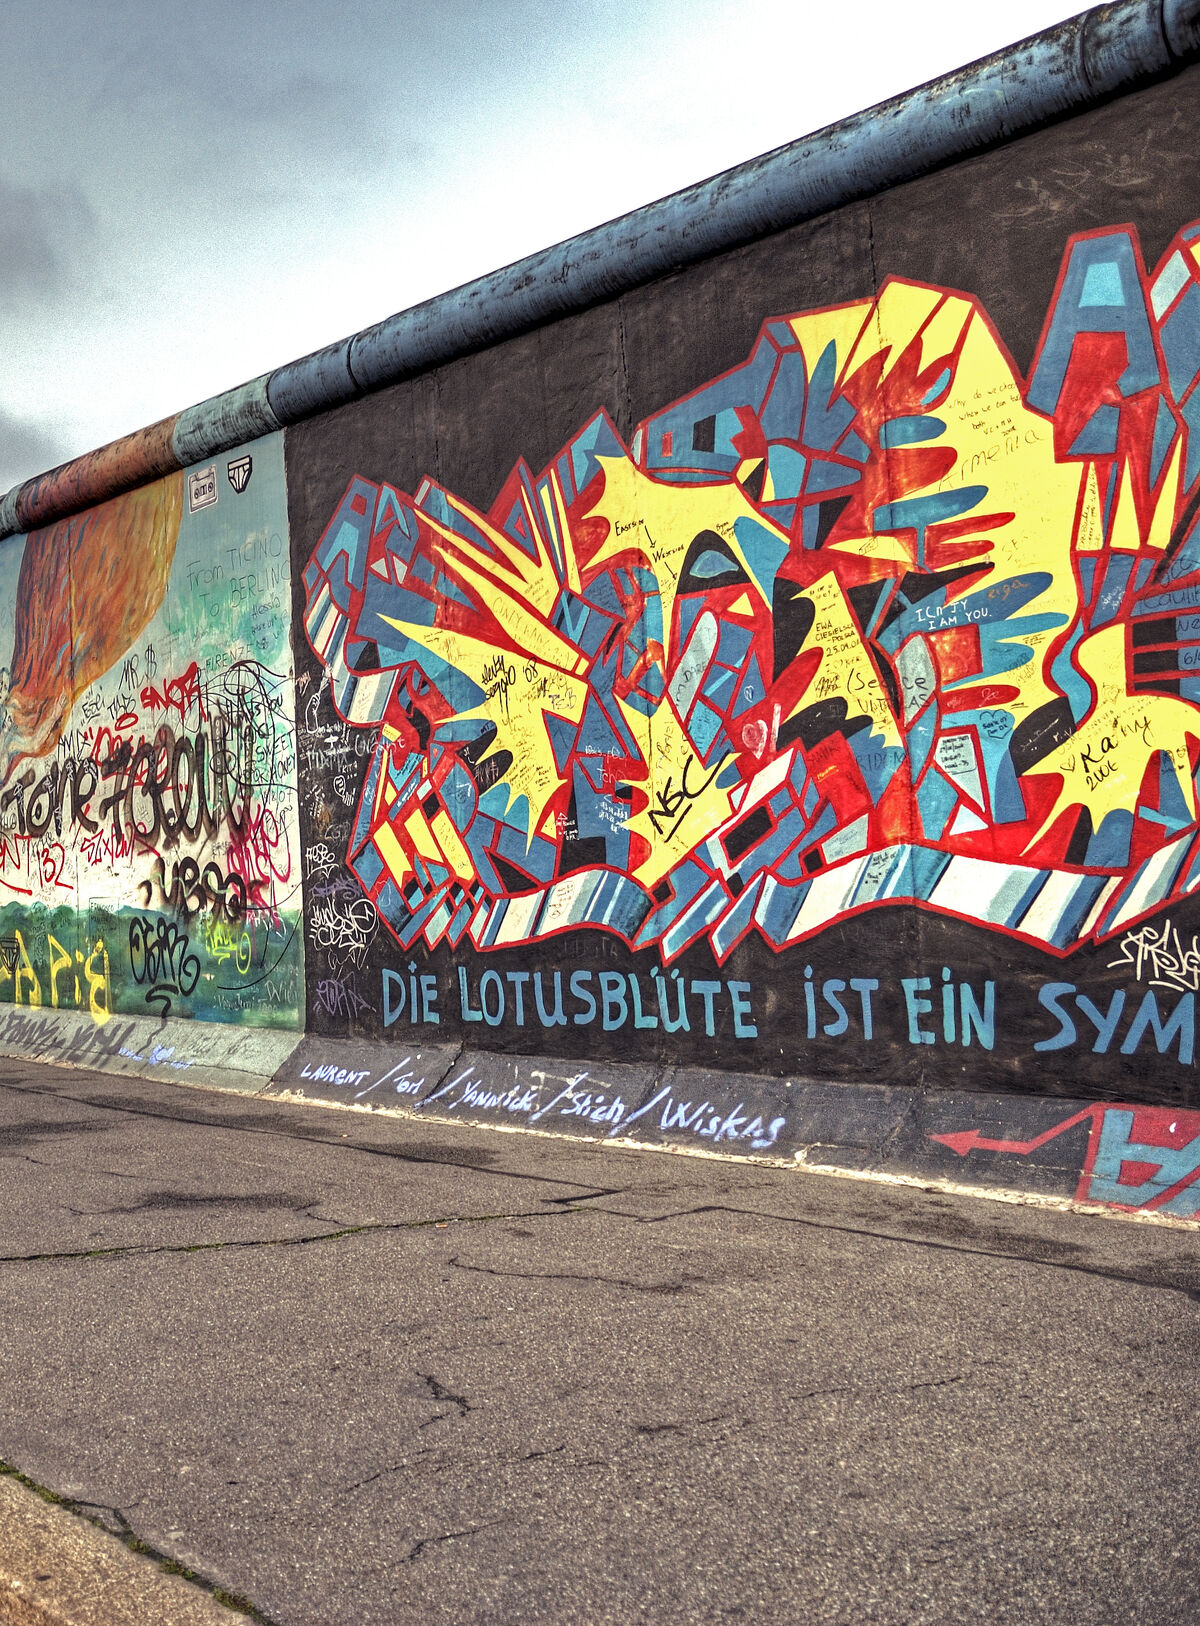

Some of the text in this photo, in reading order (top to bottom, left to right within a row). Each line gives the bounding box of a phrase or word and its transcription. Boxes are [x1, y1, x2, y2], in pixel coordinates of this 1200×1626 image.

[939, 429, 1047, 492] Armenia
[226, 532, 283, 571] TICINO
[815, 620, 832, 632] EWA
[939, 615, 957, 627] AM
[1033, 982, 1195, 1065] SYM
